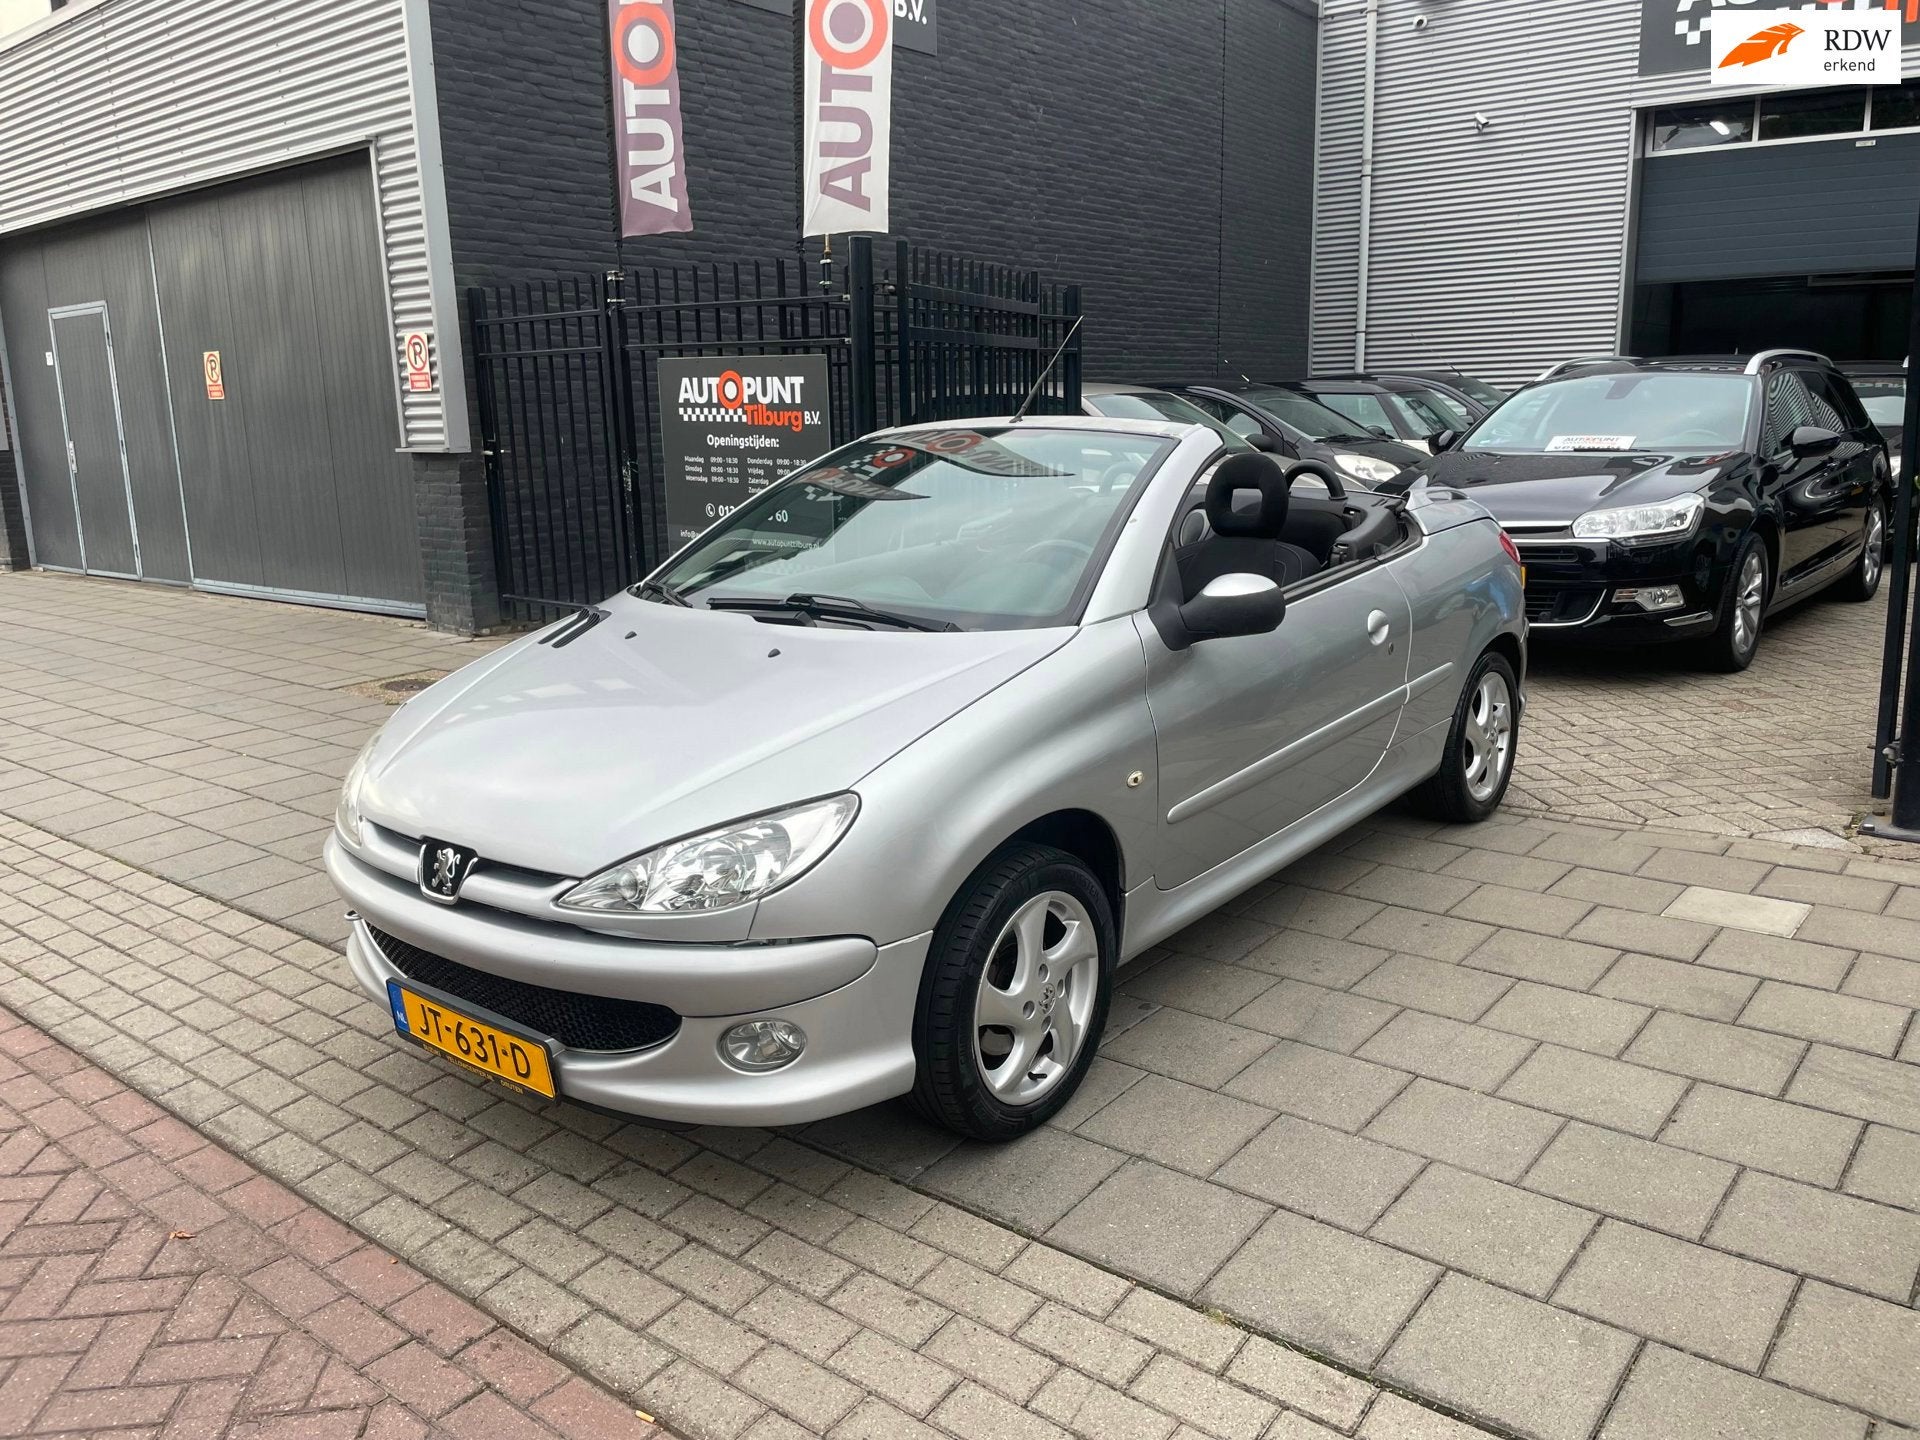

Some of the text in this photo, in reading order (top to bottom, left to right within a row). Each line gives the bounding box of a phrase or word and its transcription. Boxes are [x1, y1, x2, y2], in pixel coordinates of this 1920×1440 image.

[613, 0, 679, 213] AUTO
[678, 370, 805, 410] AUTOPUNT
[743, 404, 822, 433] Tilburg B.V.
[706, 434, 780, 450] Openingstijden:
[684, 455, 705, 464] Maandag
[710, 456, 723, 464] 09:00
[726, 457, 739, 465] 18:30
[747, 457, 773, 467] Donderdag
[776, 458, 790, 466] 09:00
[685, 464, 703, 473] Dinsdag
[710, 465, 724, 473] 09:00
[726, 466, 739, 474] 18:30
[747, 467, 764, 477] Vrijdag
[685, 474, 708, 484] Woensdag
[711, 475, 725, 483] 09:00
[748, 477, 769, 487] Zaterdag
[396, 1010, 407, 1025] NL
[419, 1003, 531, 1079] JT-631-D
